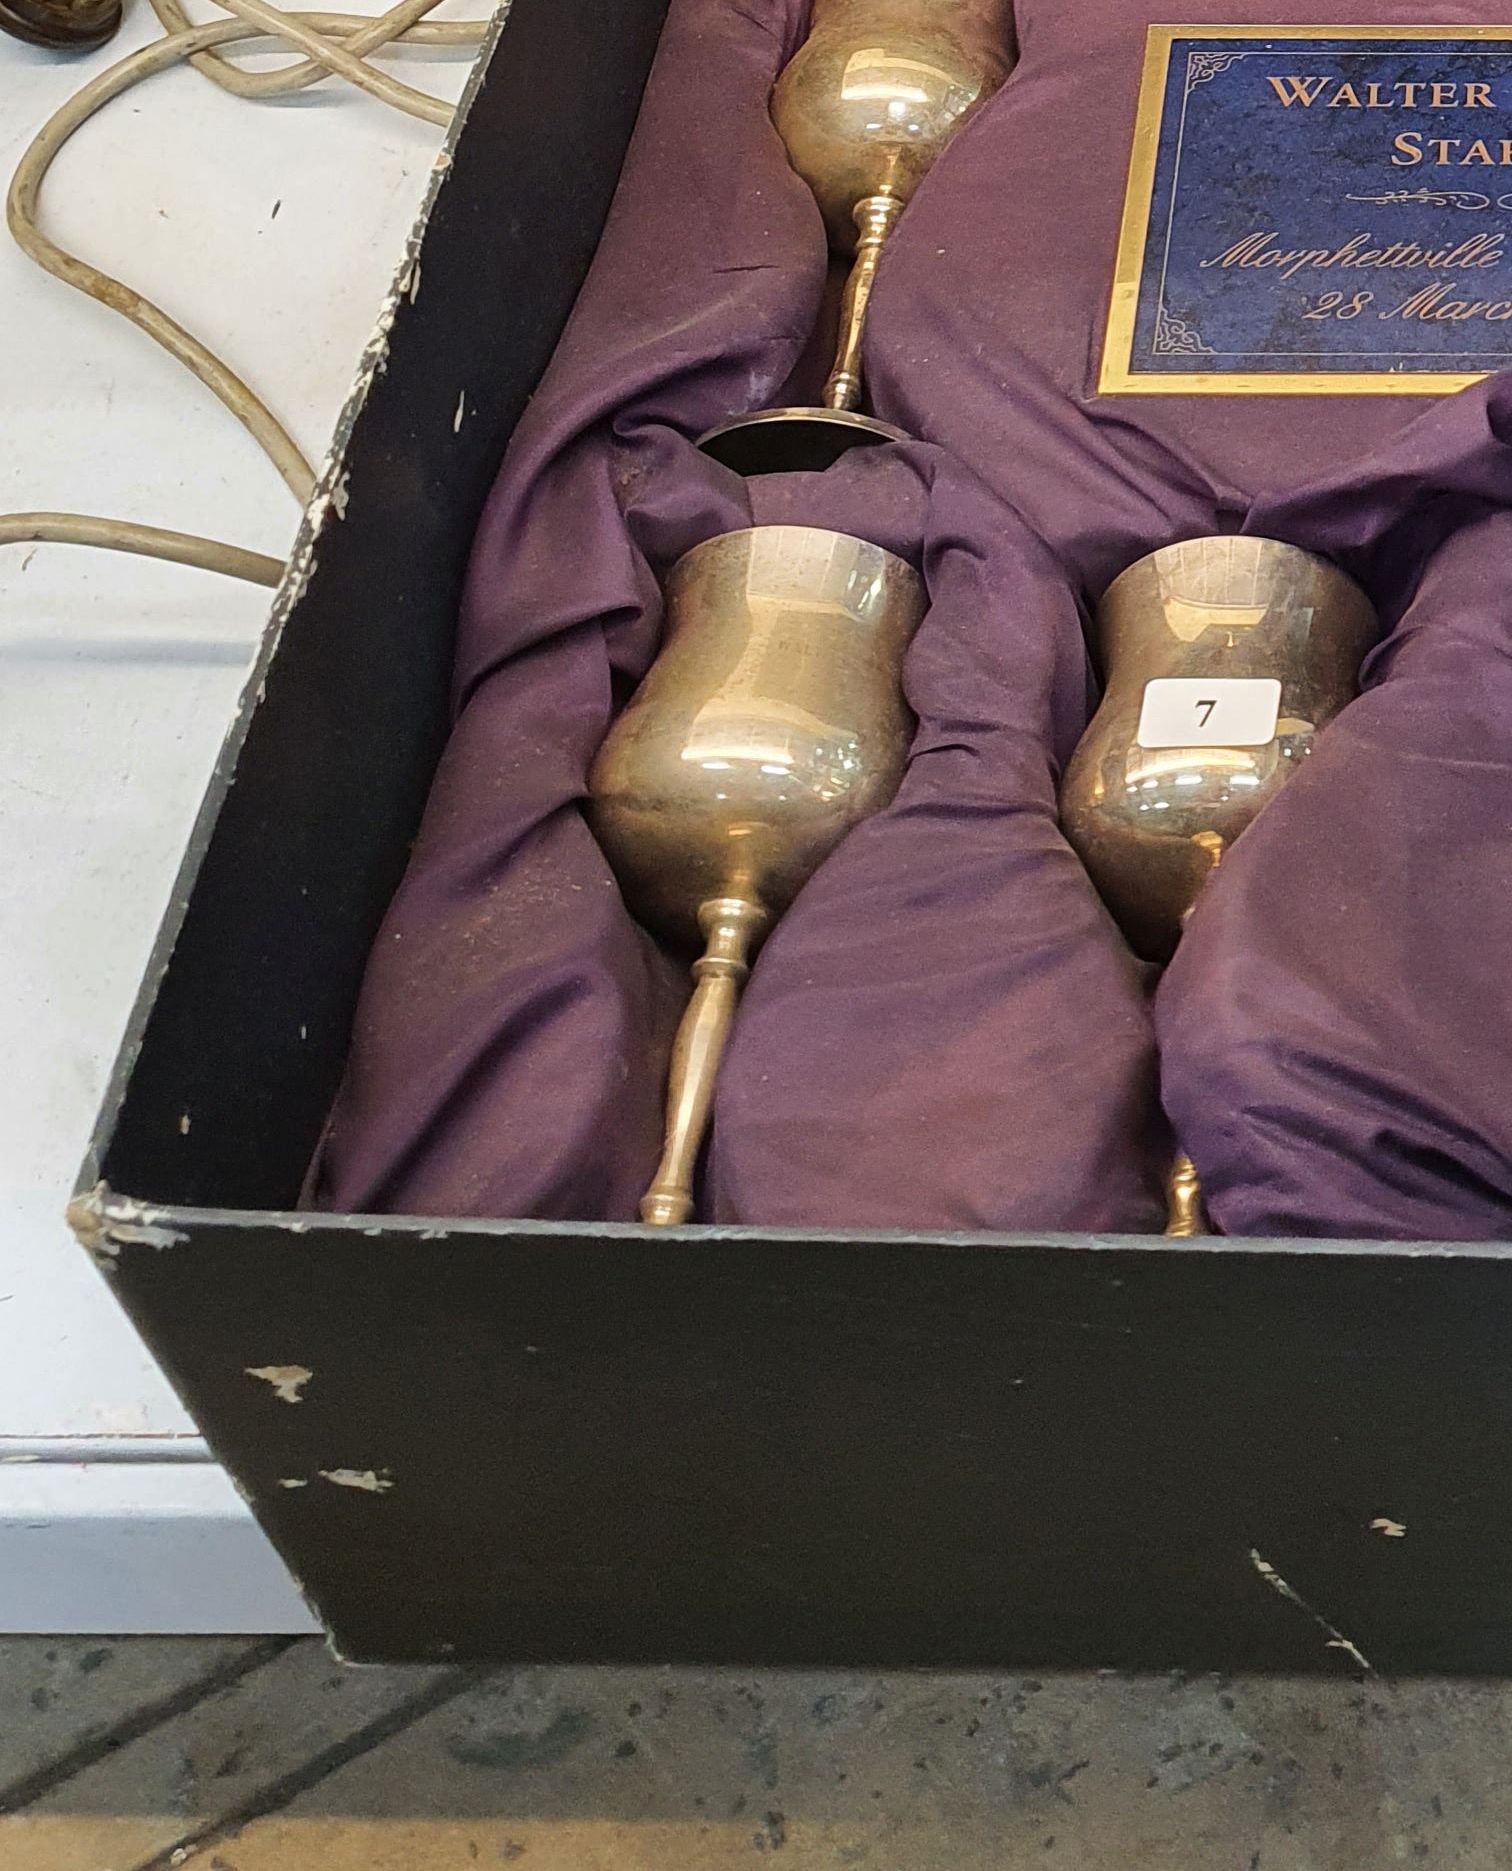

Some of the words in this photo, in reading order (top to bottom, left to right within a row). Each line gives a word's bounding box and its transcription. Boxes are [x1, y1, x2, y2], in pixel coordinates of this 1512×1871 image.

[1268, 75, 1496, 108] WALTER
[1199, 231, 1506, 279] Morphettville
[1302, 290, 1374, 321] 28
[1194, 699, 1218, 728] 7
